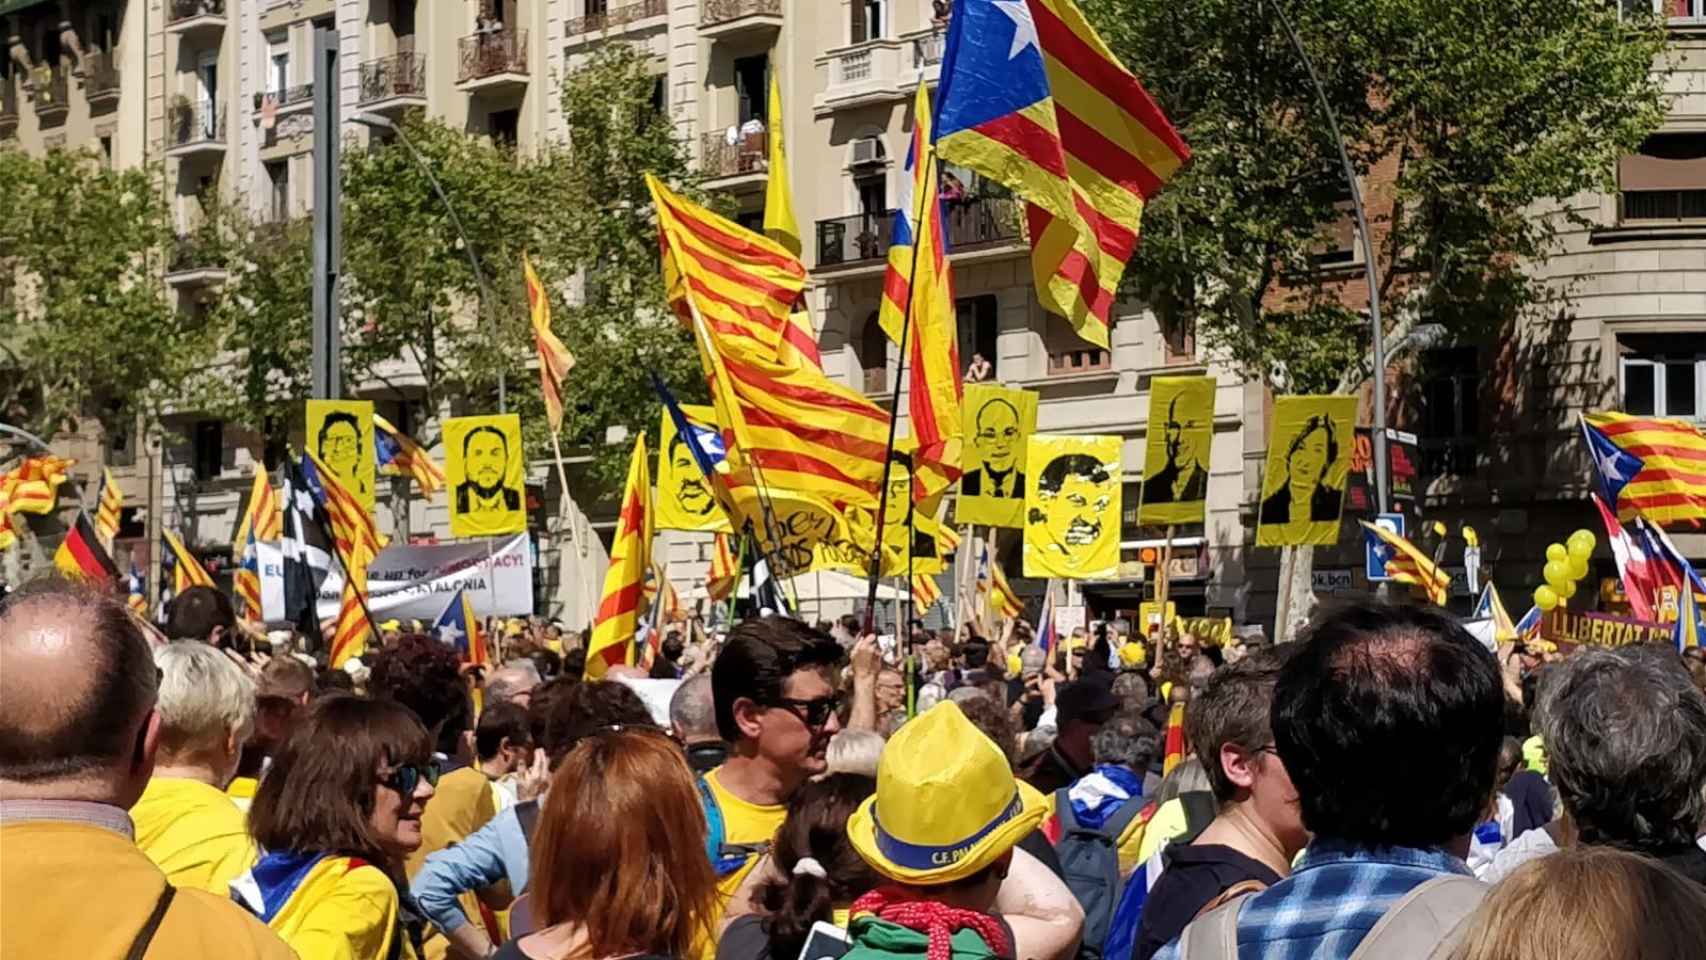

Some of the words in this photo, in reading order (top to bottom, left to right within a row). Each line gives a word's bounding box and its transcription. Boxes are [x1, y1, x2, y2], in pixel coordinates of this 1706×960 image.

[384, 570, 404, 581] up
[408, 568, 429, 581] for
[1552, 609, 1644, 648] LLIBERTAT
